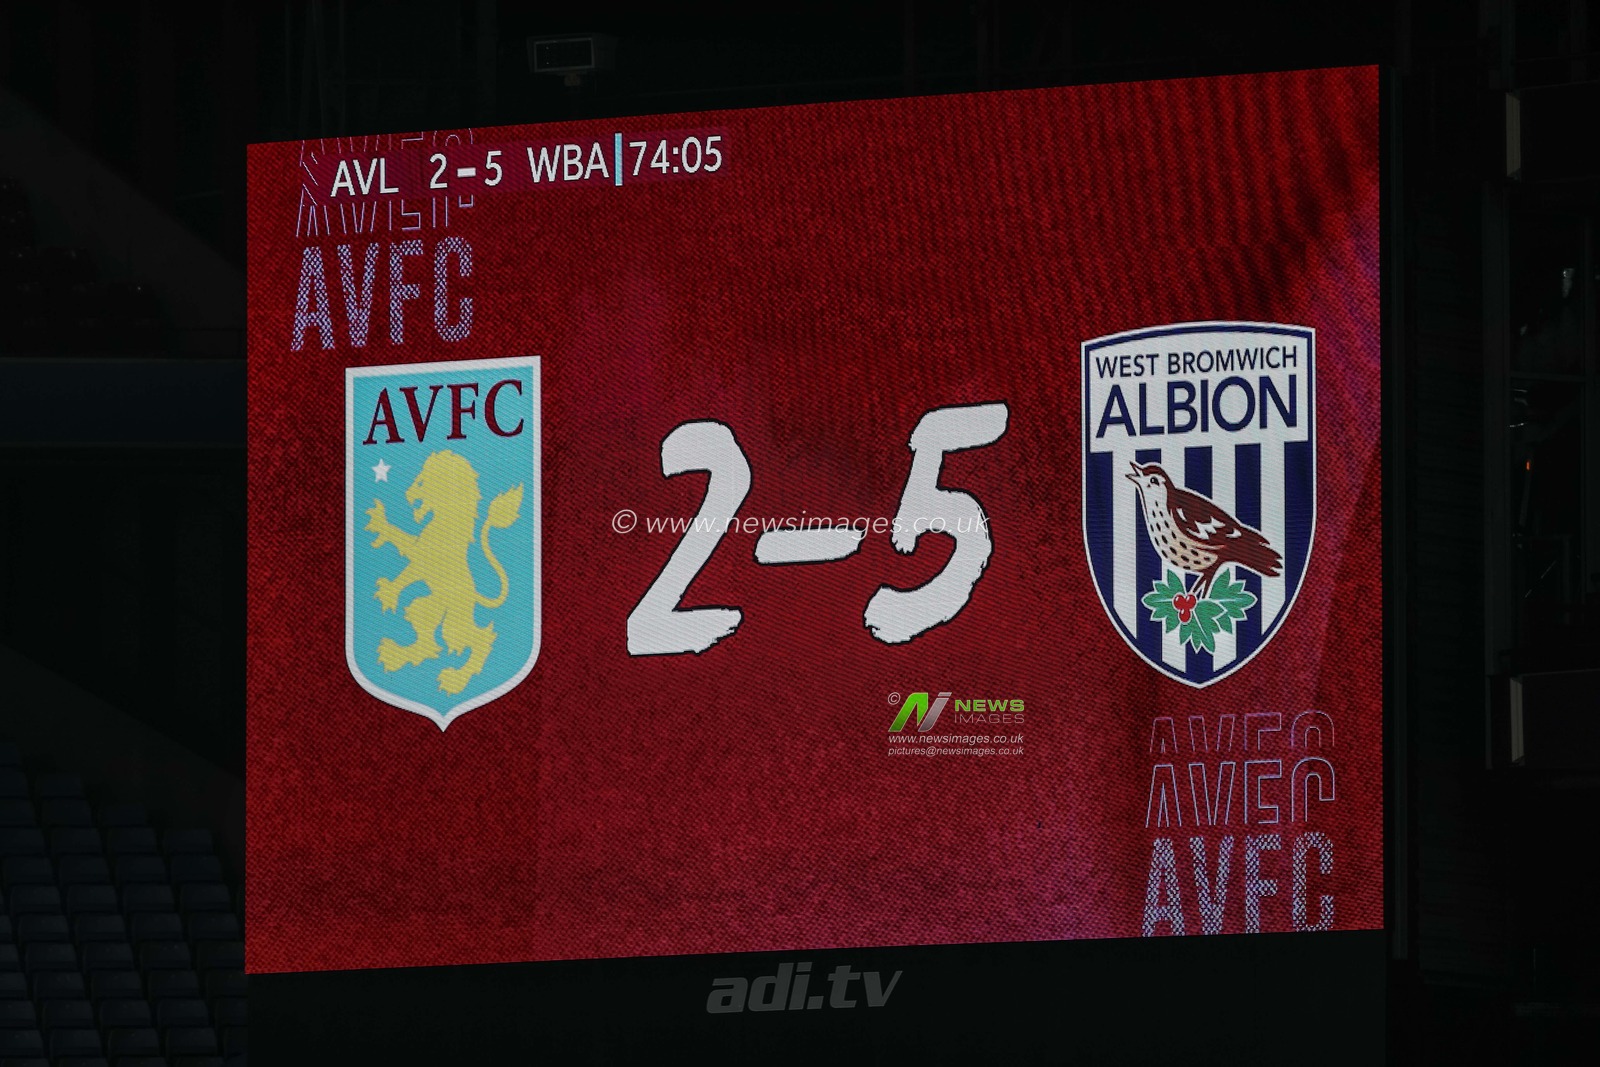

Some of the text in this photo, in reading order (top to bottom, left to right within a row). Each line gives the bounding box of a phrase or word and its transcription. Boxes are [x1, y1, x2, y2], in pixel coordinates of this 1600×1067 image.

[330, 157, 399, 197] AVL
[527, 142, 609, 183] WBA
[629, 135, 723, 176] 74:05
[291, 236, 473, 351] AVFC
[1095, 345, 1297, 378] WEST BROMWICH
[363, 379, 524, 445] AVFC
[1095, 374, 1297, 438] ALBION
[1142, 831, 1334, 937] AVFC
[706, 962, 903, 1014] adi.tv
